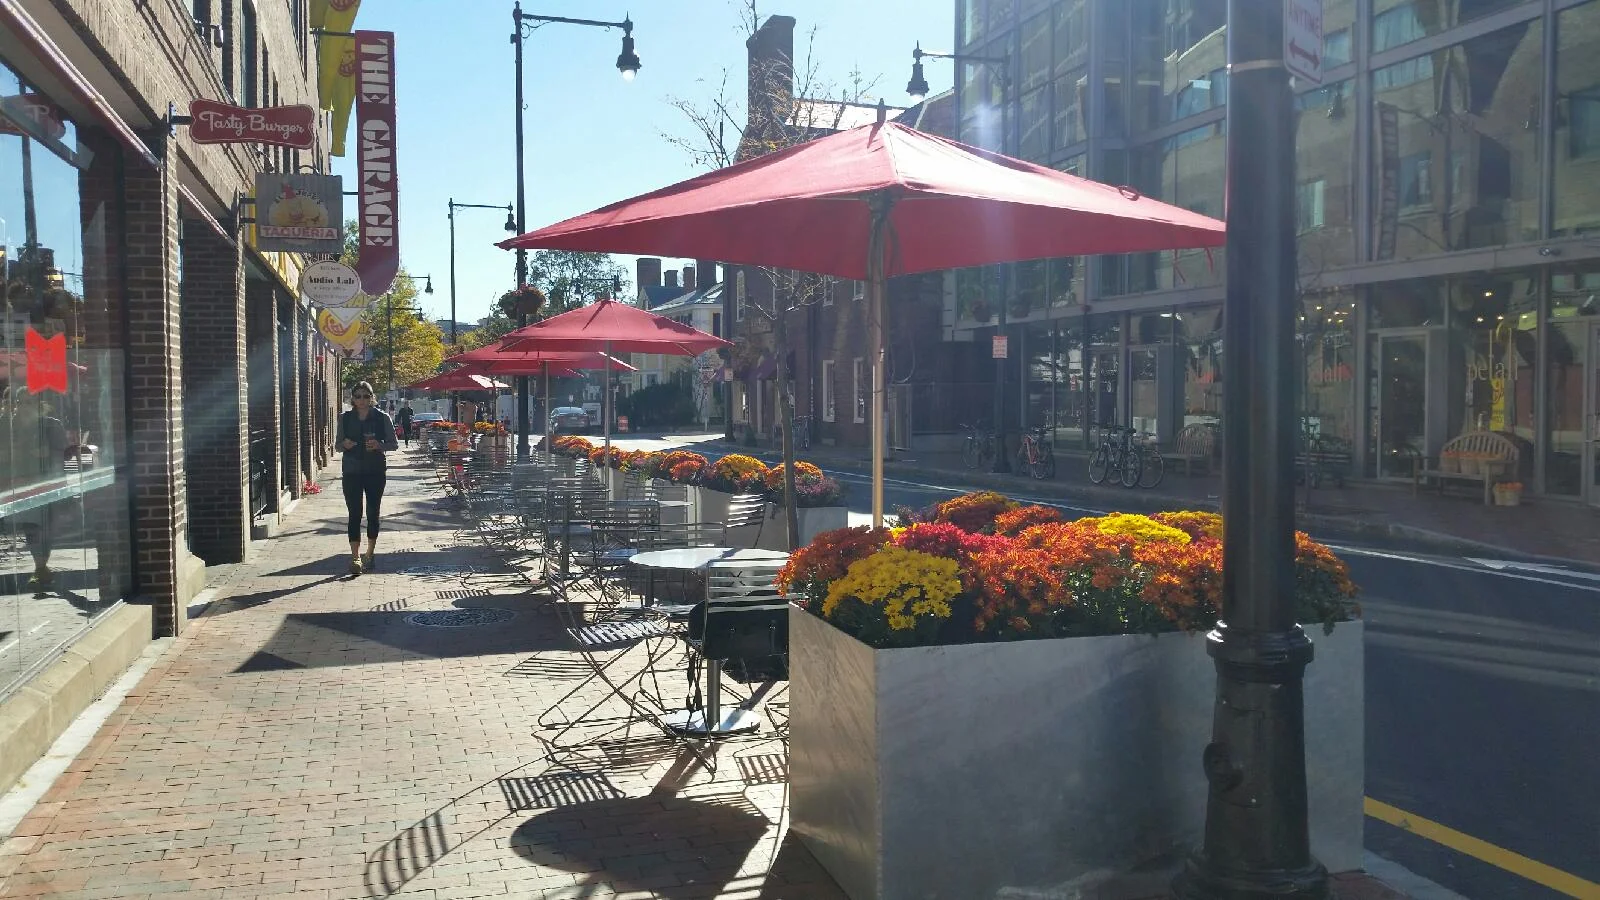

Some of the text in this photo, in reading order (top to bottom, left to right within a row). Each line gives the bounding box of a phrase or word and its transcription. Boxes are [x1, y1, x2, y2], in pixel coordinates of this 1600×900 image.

[199, 110, 304, 139] Tasty Burger
[361, 38, 393, 246] THE GARAGE
[262, 227, 335, 238] TAQUERIA
[308, 275, 355, 285] Audio Lab
